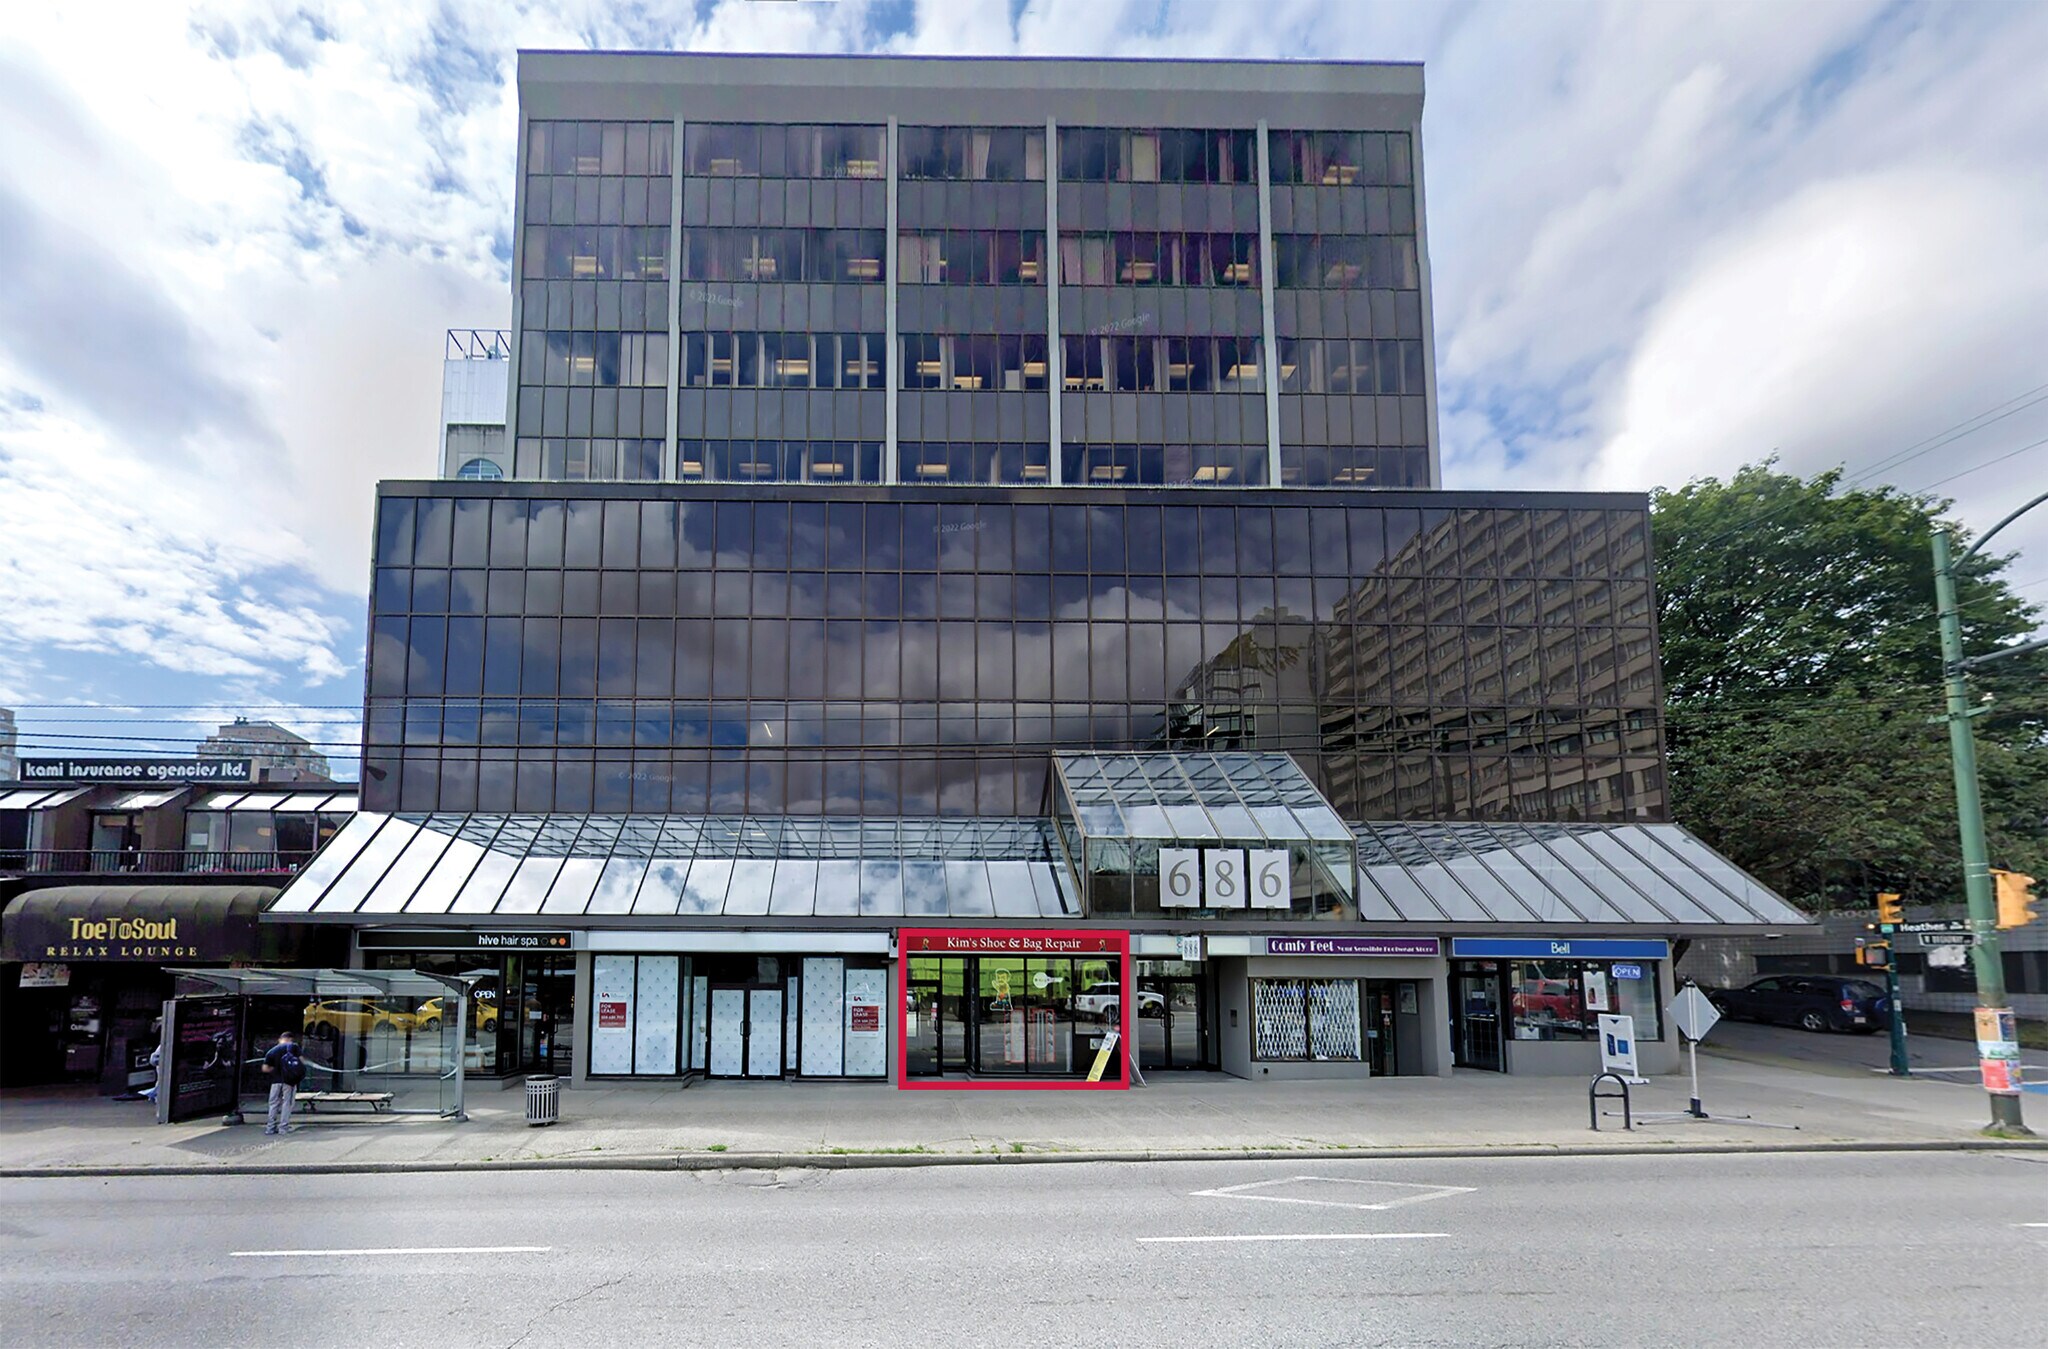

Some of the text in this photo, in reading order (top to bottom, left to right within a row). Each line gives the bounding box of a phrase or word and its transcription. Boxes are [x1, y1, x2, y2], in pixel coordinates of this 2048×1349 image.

[26, 762, 247, 781] kami insurance agencies ltd.
[1168, 858, 1283, 898] 686
[69, 917, 178, 940] ToeToSoul
[478, 934, 539, 949] hive hair spa
[947, 937, 1081, 951] Kim's Shoe & Bag Repair
[1271, 940, 1334, 953] Comfy Feet
[1551, 942, 1571, 954] Bell
[46, 946, 198, 956] RELAX LOUNGE
[1615, 967, 1640, 977] OPEN
[474, 990, 496, 999] OPEN
